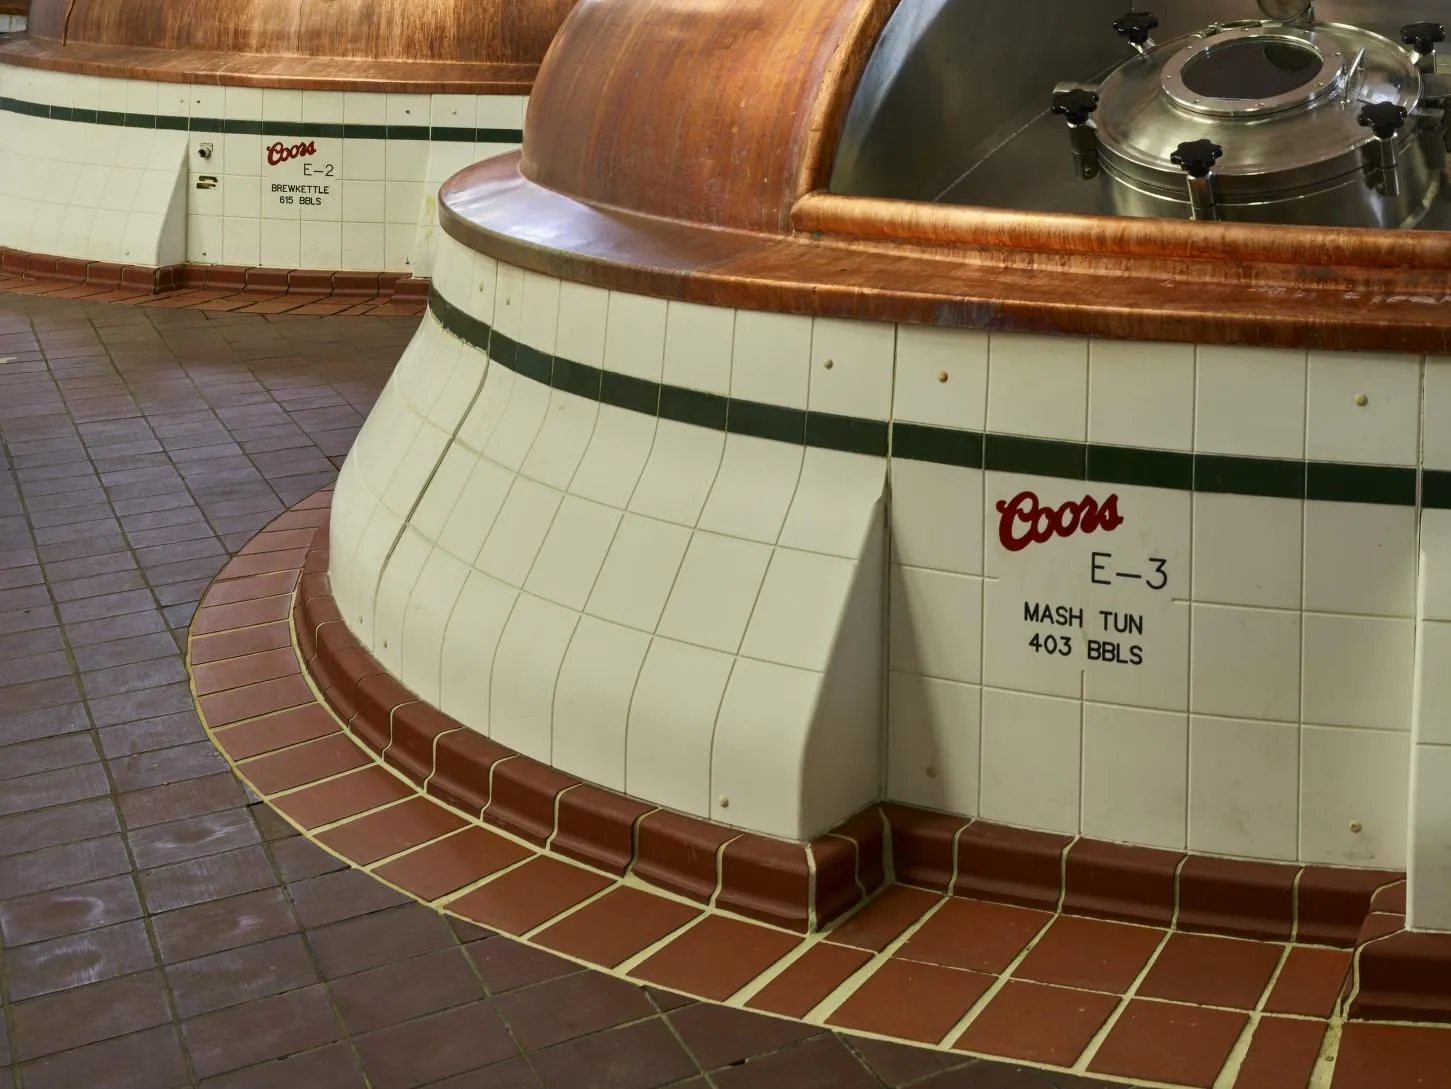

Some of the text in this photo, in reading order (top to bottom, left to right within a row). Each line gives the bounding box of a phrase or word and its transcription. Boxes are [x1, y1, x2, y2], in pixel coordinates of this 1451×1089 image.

[266, 141, 317, 166] Coors
[303, 163, 334, 177] E-2
[271, 184, 330, 194] BREWKETTLE
[280, 195, 322, 206] 615 BBLS
[996, 491, 1124, 552] Coors
[1091, 552, 1168, 590] E-3
[1023, 601, 1143, 636] MASH TUN
[1029, 633, 1143, 665] 403 BBLS
